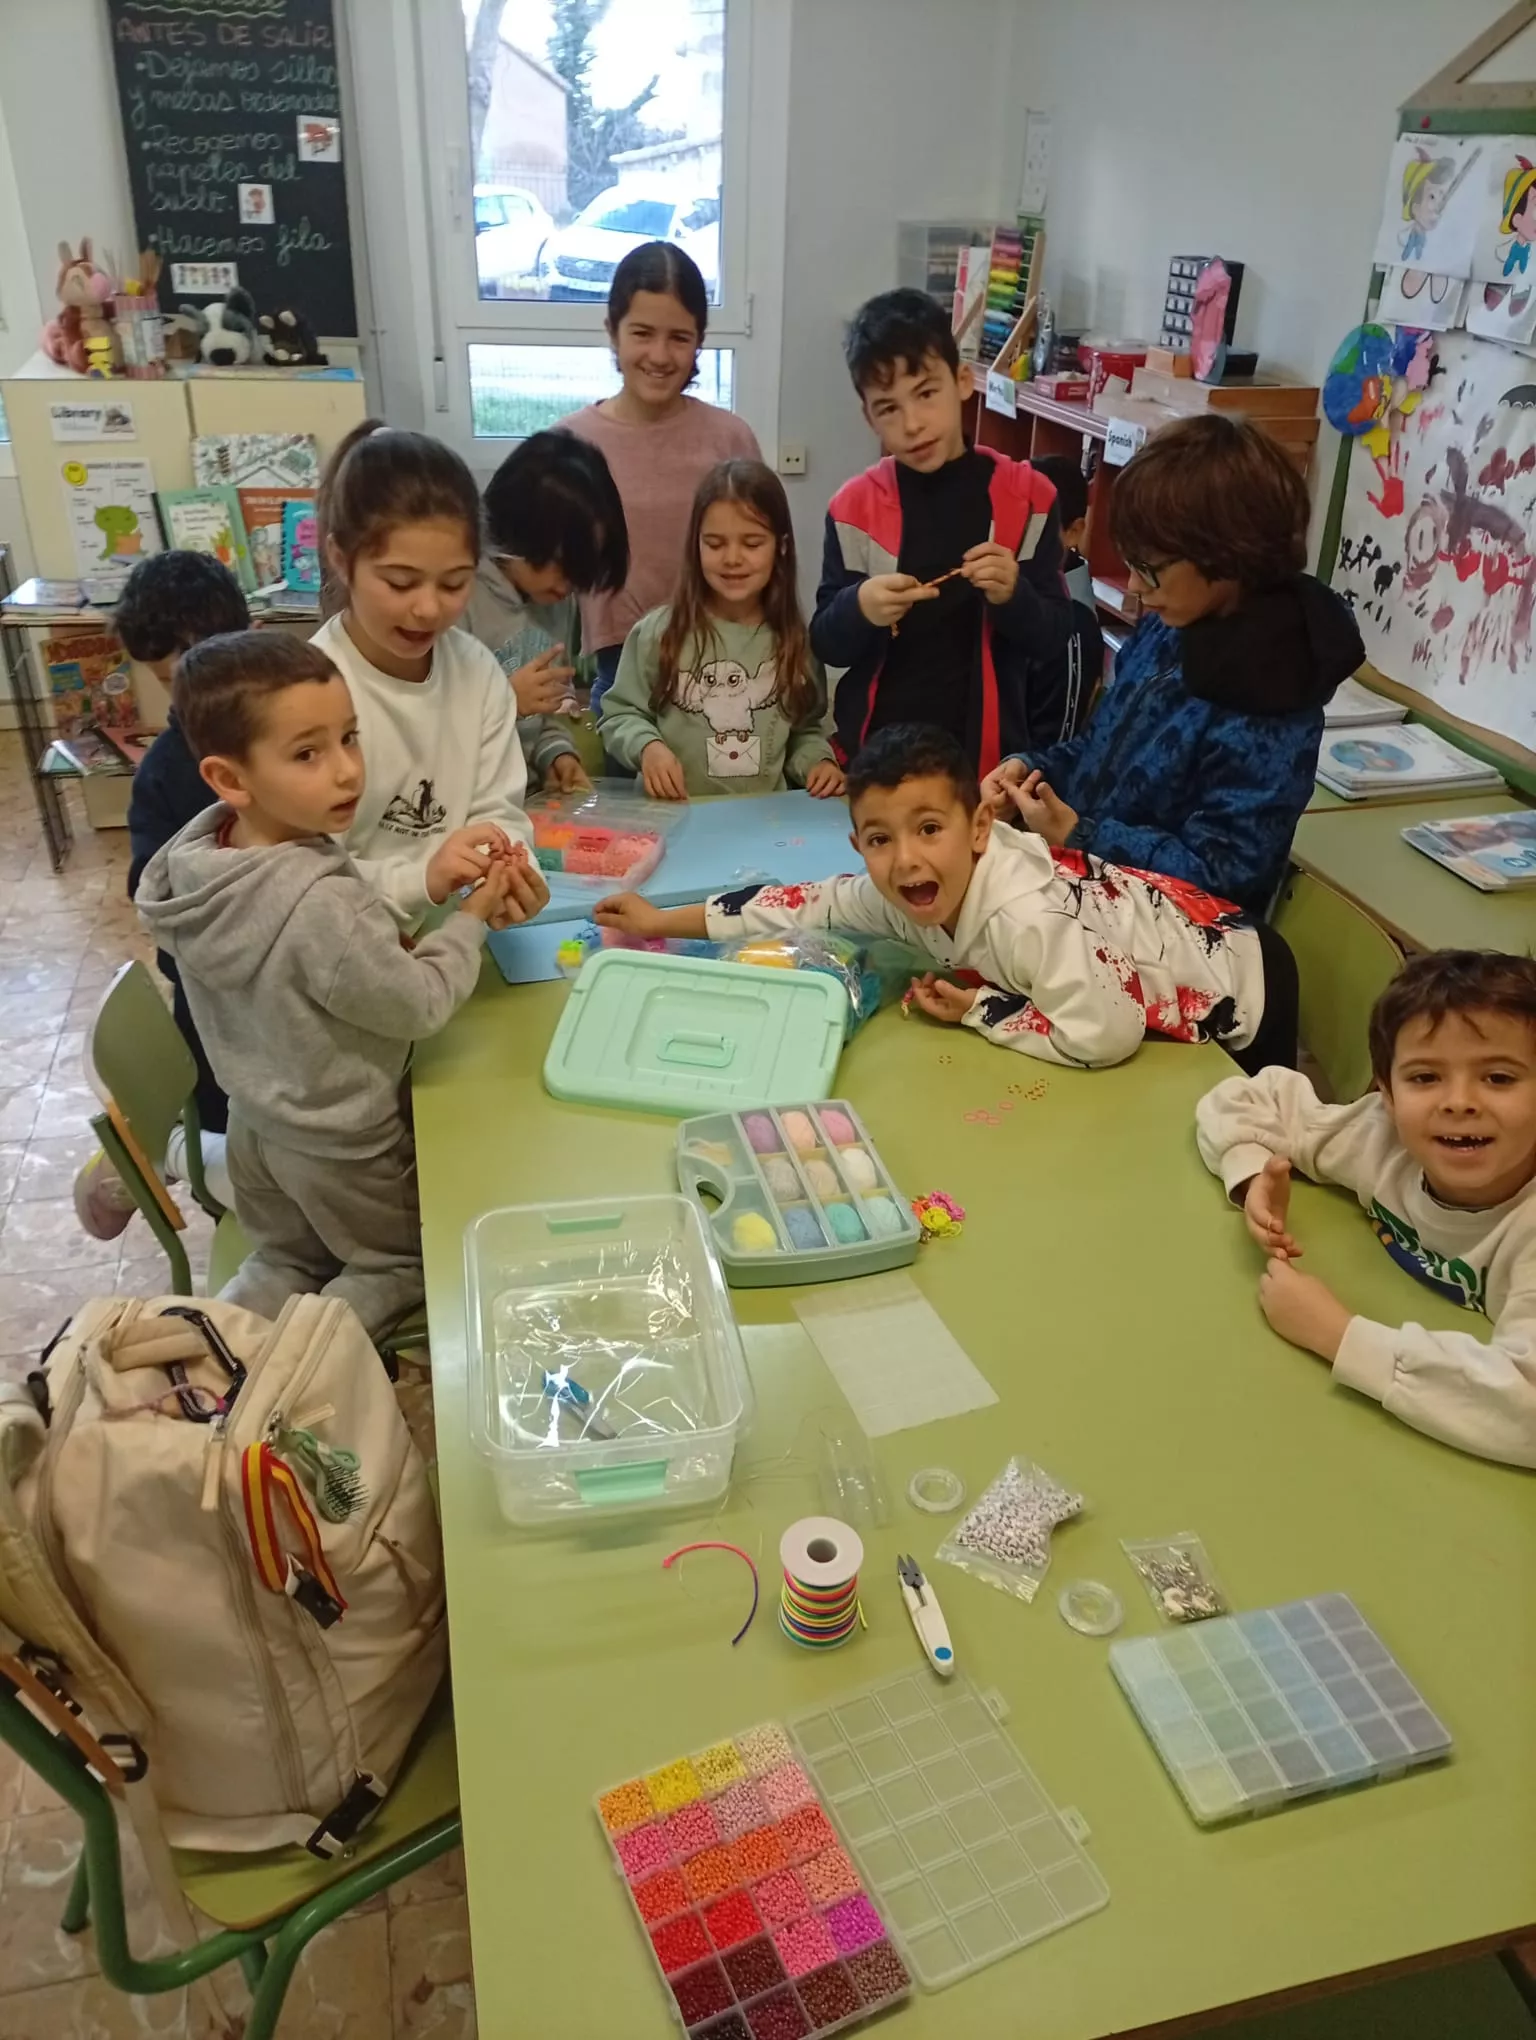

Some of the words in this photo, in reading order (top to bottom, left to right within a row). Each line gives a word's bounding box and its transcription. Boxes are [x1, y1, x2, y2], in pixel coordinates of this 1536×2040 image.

[117, 18, 207, 46] ANTES
[217, 22, 253, 46] DE
[1108, 429, 1132, 448] Spanish
